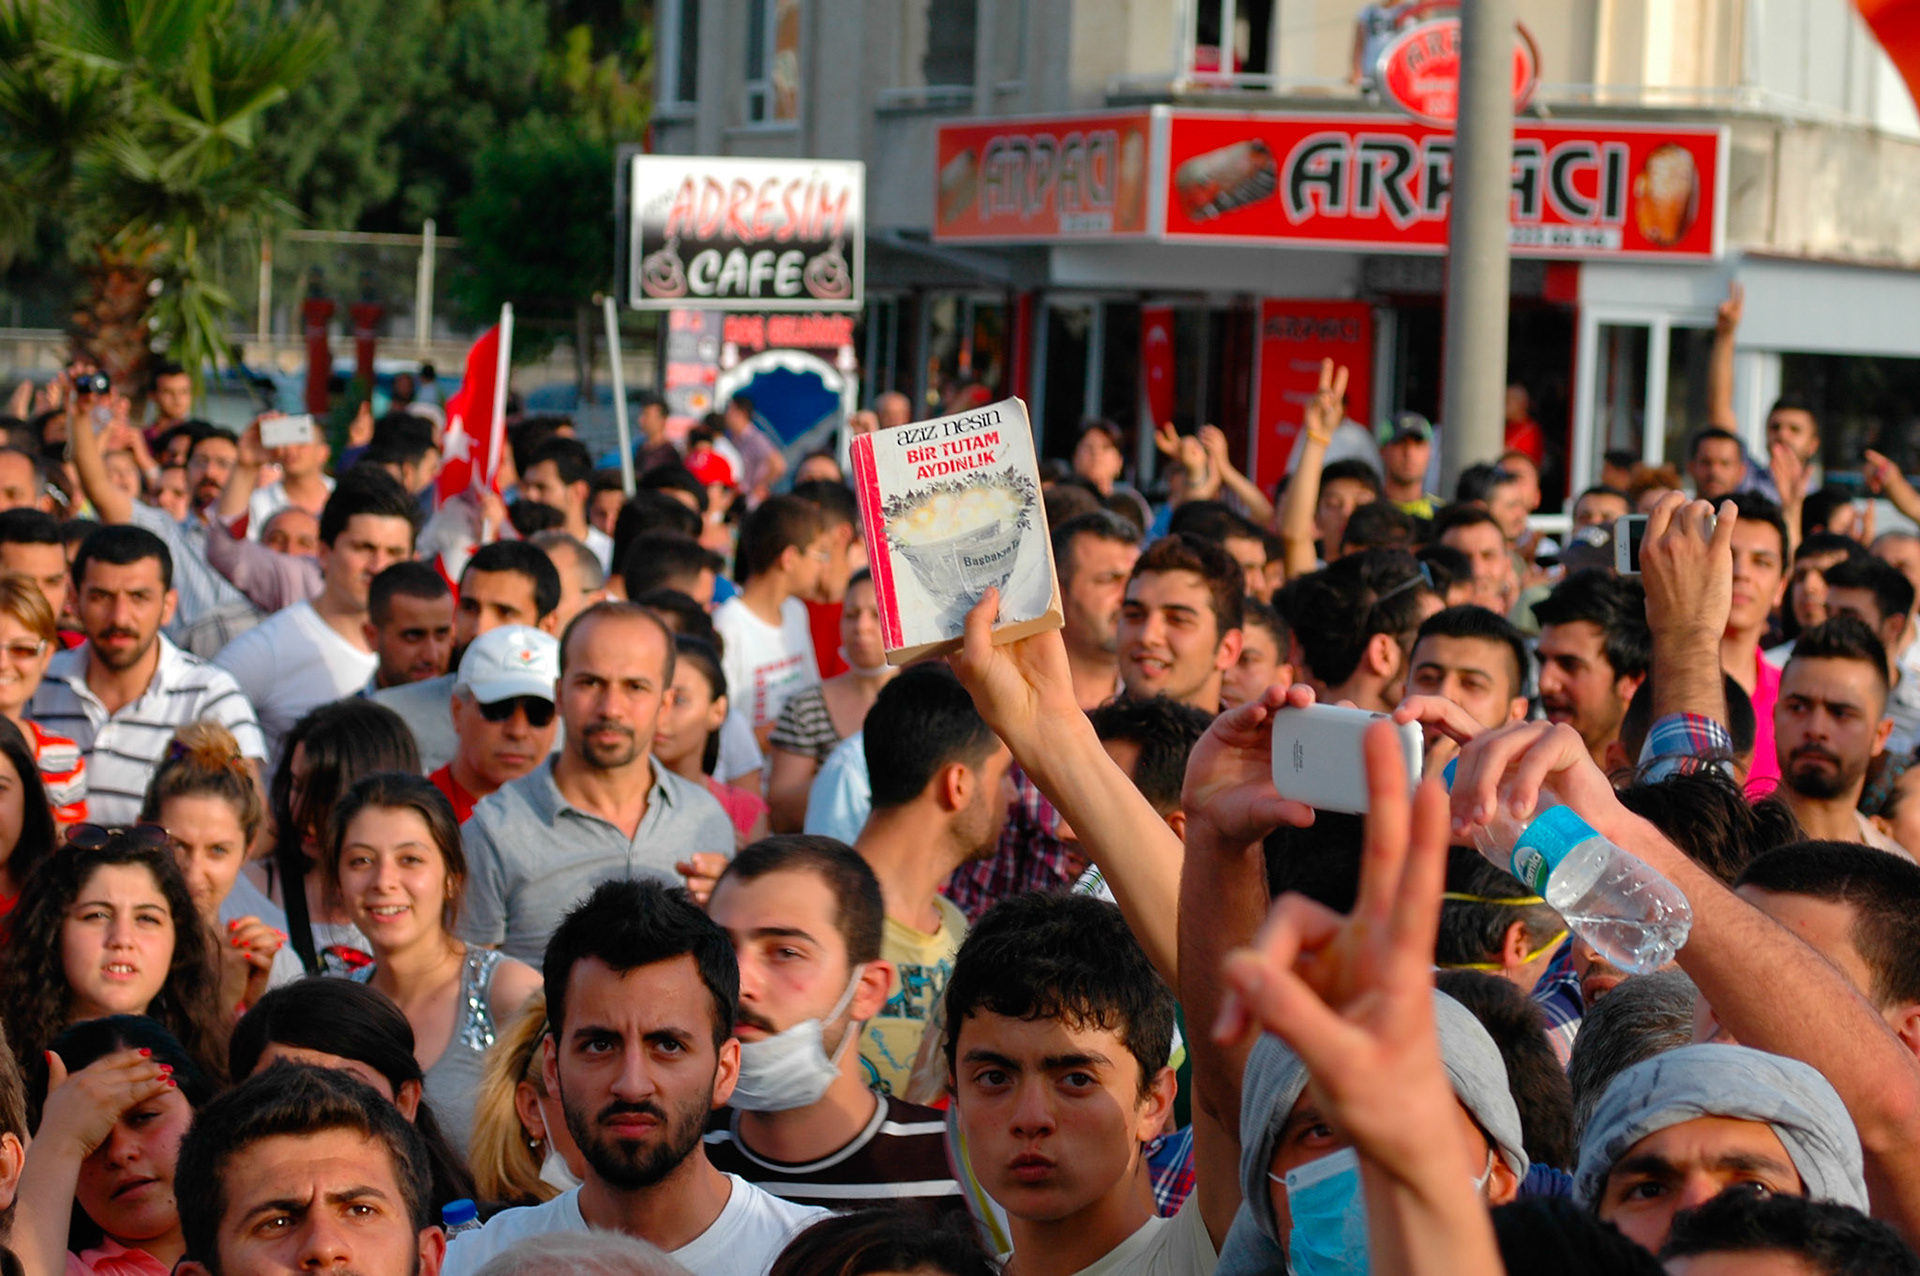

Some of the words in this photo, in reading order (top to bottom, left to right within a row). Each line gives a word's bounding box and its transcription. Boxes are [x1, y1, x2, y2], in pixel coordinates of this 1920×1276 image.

[688, 248, 805, 297] CAFE
[897, 426, 938, 446] aziz
[943, 408, 1002, 438] nesin
[906, 445, 937, 464] BİR
[939, 431, 1001, 458] TUTAM
[916, 451, 997, 480] AYDINLIK
